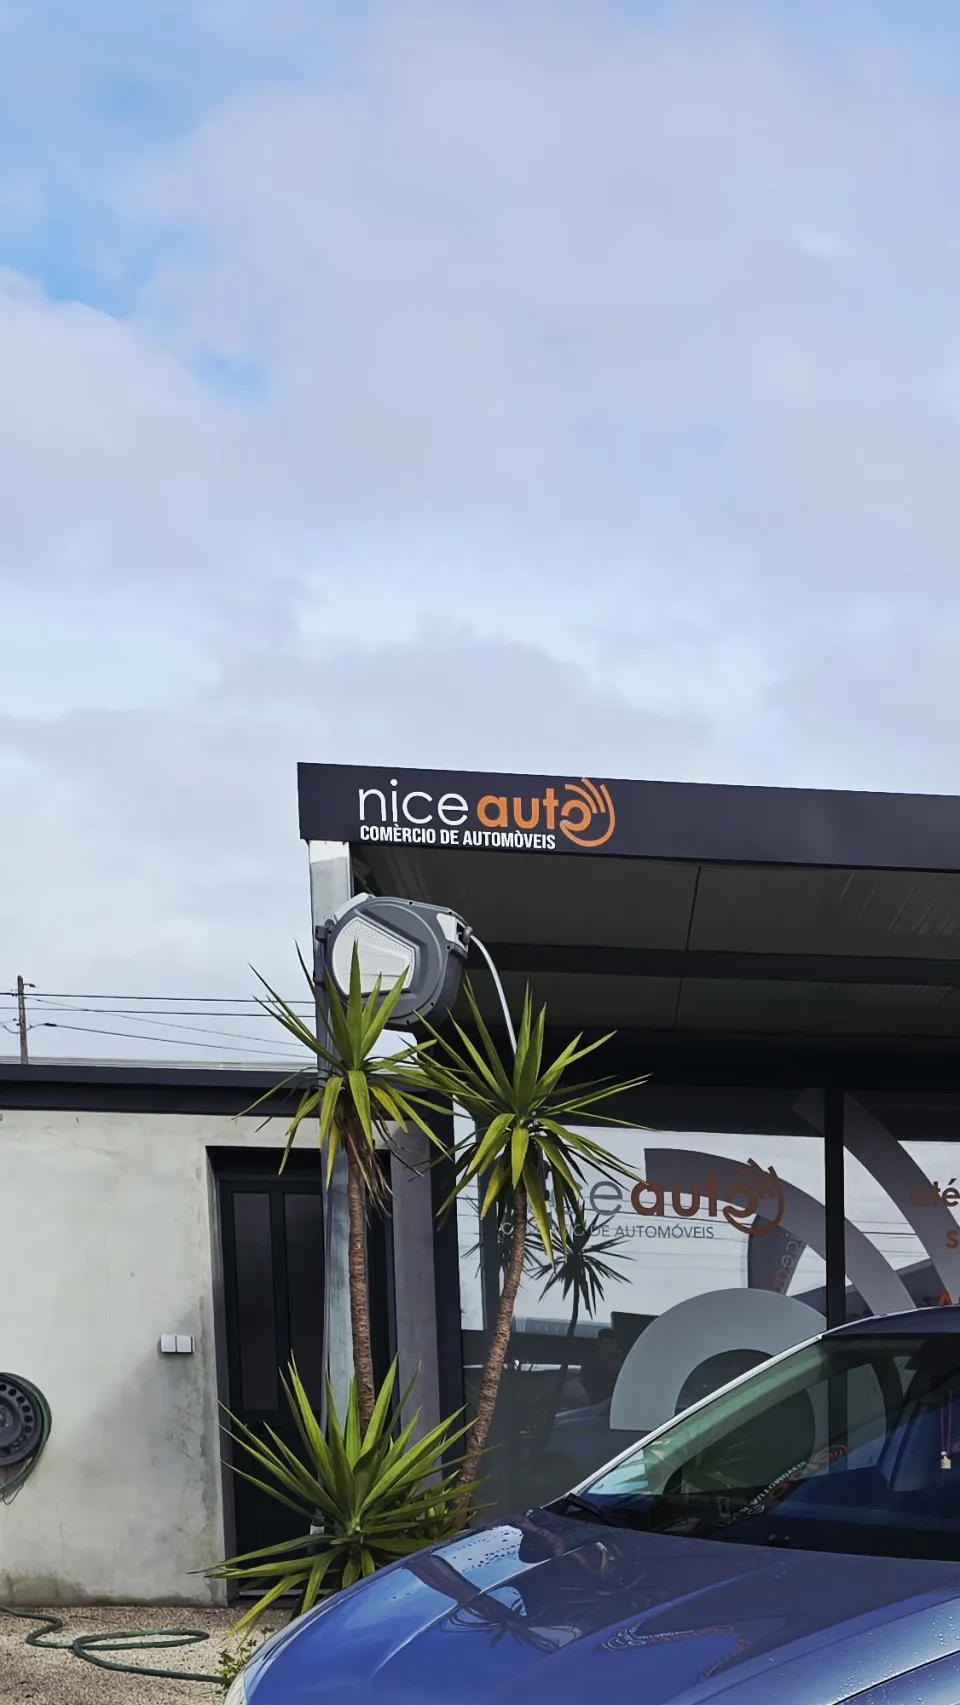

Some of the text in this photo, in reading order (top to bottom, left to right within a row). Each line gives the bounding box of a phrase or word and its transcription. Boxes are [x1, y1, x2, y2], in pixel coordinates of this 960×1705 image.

[440, 828, 459, 846] DE
[909, 1178, 960, 1208] até
[614, 1222, 715, 1239] AUTOMÓVEIS
